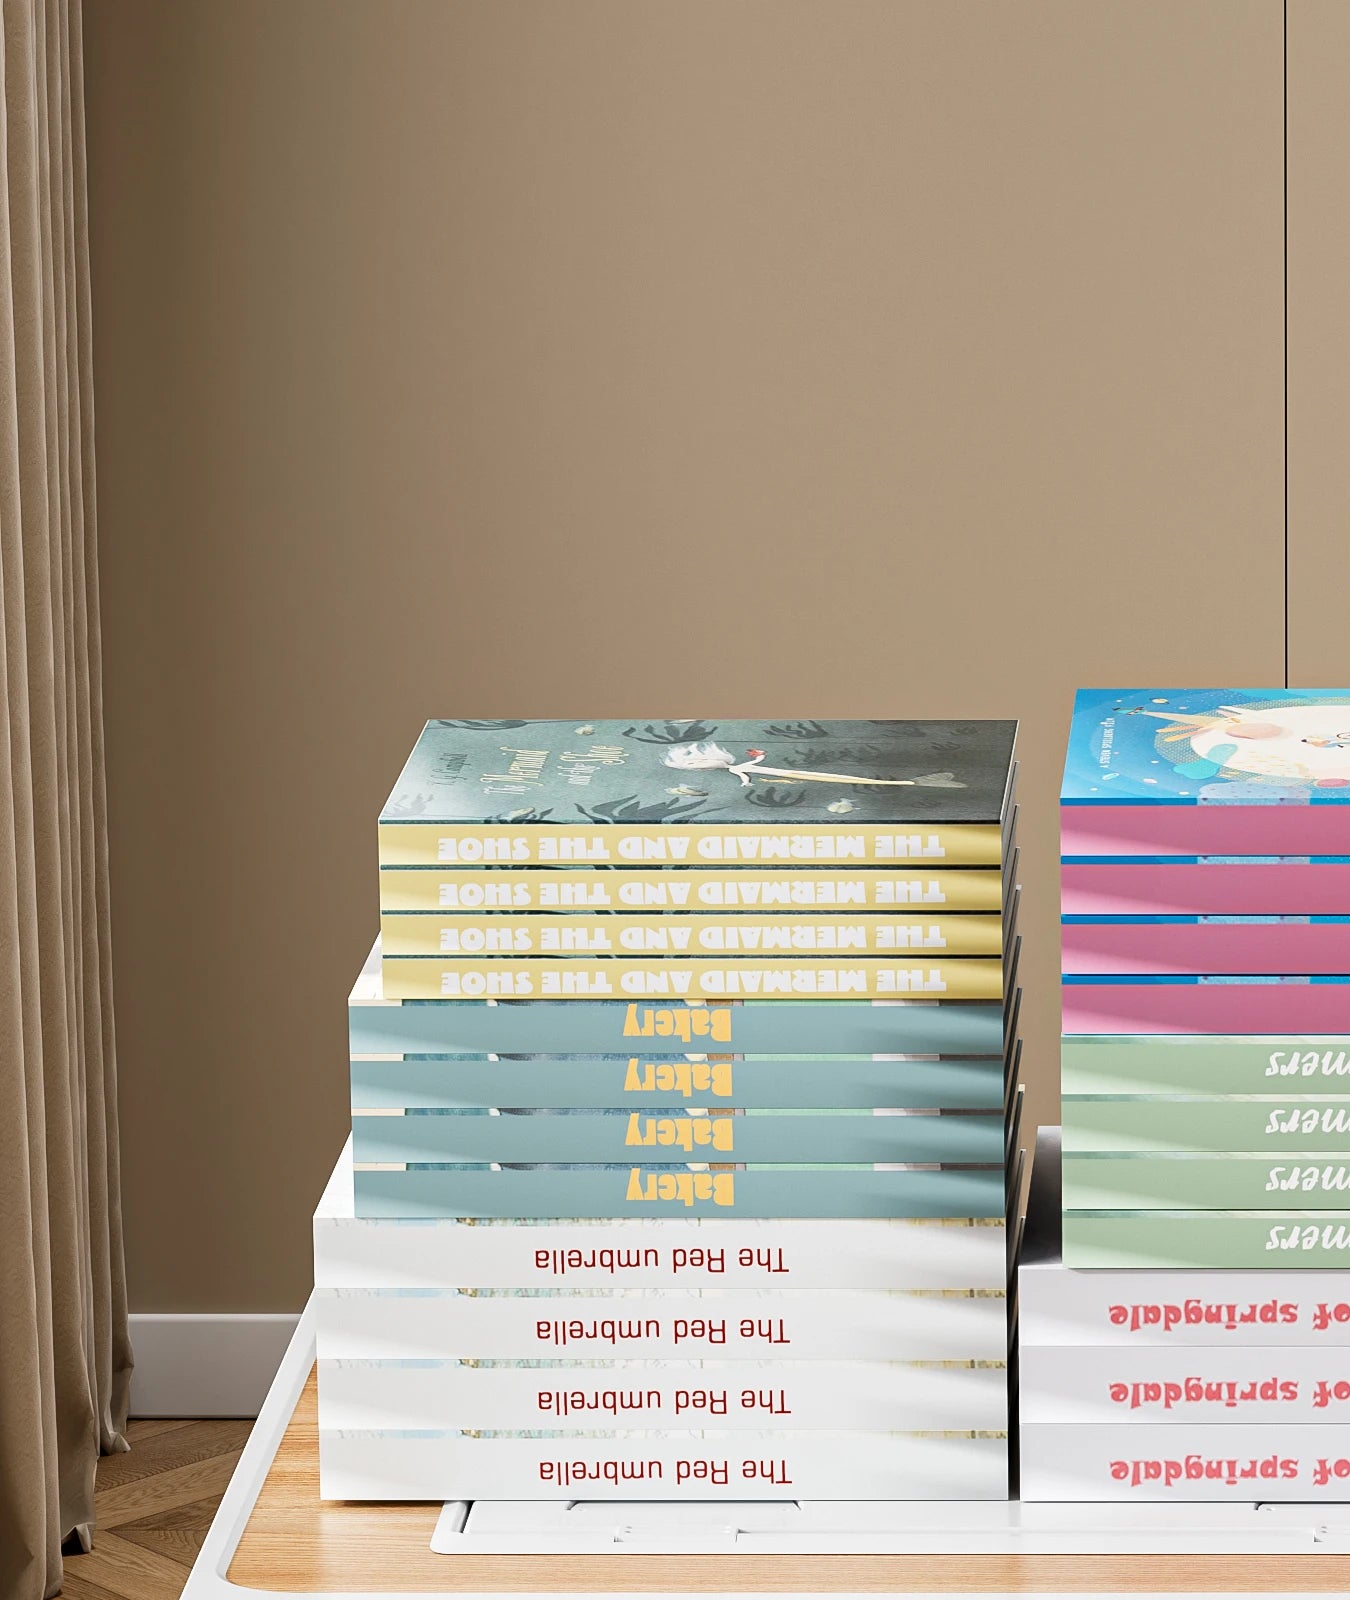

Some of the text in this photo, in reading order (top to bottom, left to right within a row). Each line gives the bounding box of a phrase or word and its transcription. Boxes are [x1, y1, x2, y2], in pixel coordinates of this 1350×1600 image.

[480, 746, 550, 787] Mermaid
[558, 745, 630, 766] Shoe
[437, 835, 944, 861] THE MERMAID AND THE SHOE
[438, 881, 945, 906] THE MERMAID AND THE SHOE
[439, 926, 945, 950] THE MERMAID AND THE SHOE
[440, 970, 946, 994] THE MERMAID AND THE SHOE
[624, 1005, 731, 1042] Bakery
[625, 1059, 732, 1097] Bakery
[626, 1112, 733, 1151] Bakery
[627, 1167, 734, 1206] Bakery
[536, 1249, 786, 1272] The Red umbrella
[1109, 1300, 1297, 1332] springdale
[1313, 1302, 1350, 1331] of
[537, 1321, 787, 1343] The Red umbrella
[539, 1391, 788, 1414] The Red umbrella
[1110, 1378, 1297, 1409] springdale
[1313, 1380, 1350, 1408] of
[540, 1462, 790, 1484] The Red umbrella
[1111, 1456, 1297, 1487] springdale
[1314, 1458, 1350, 1486] of
